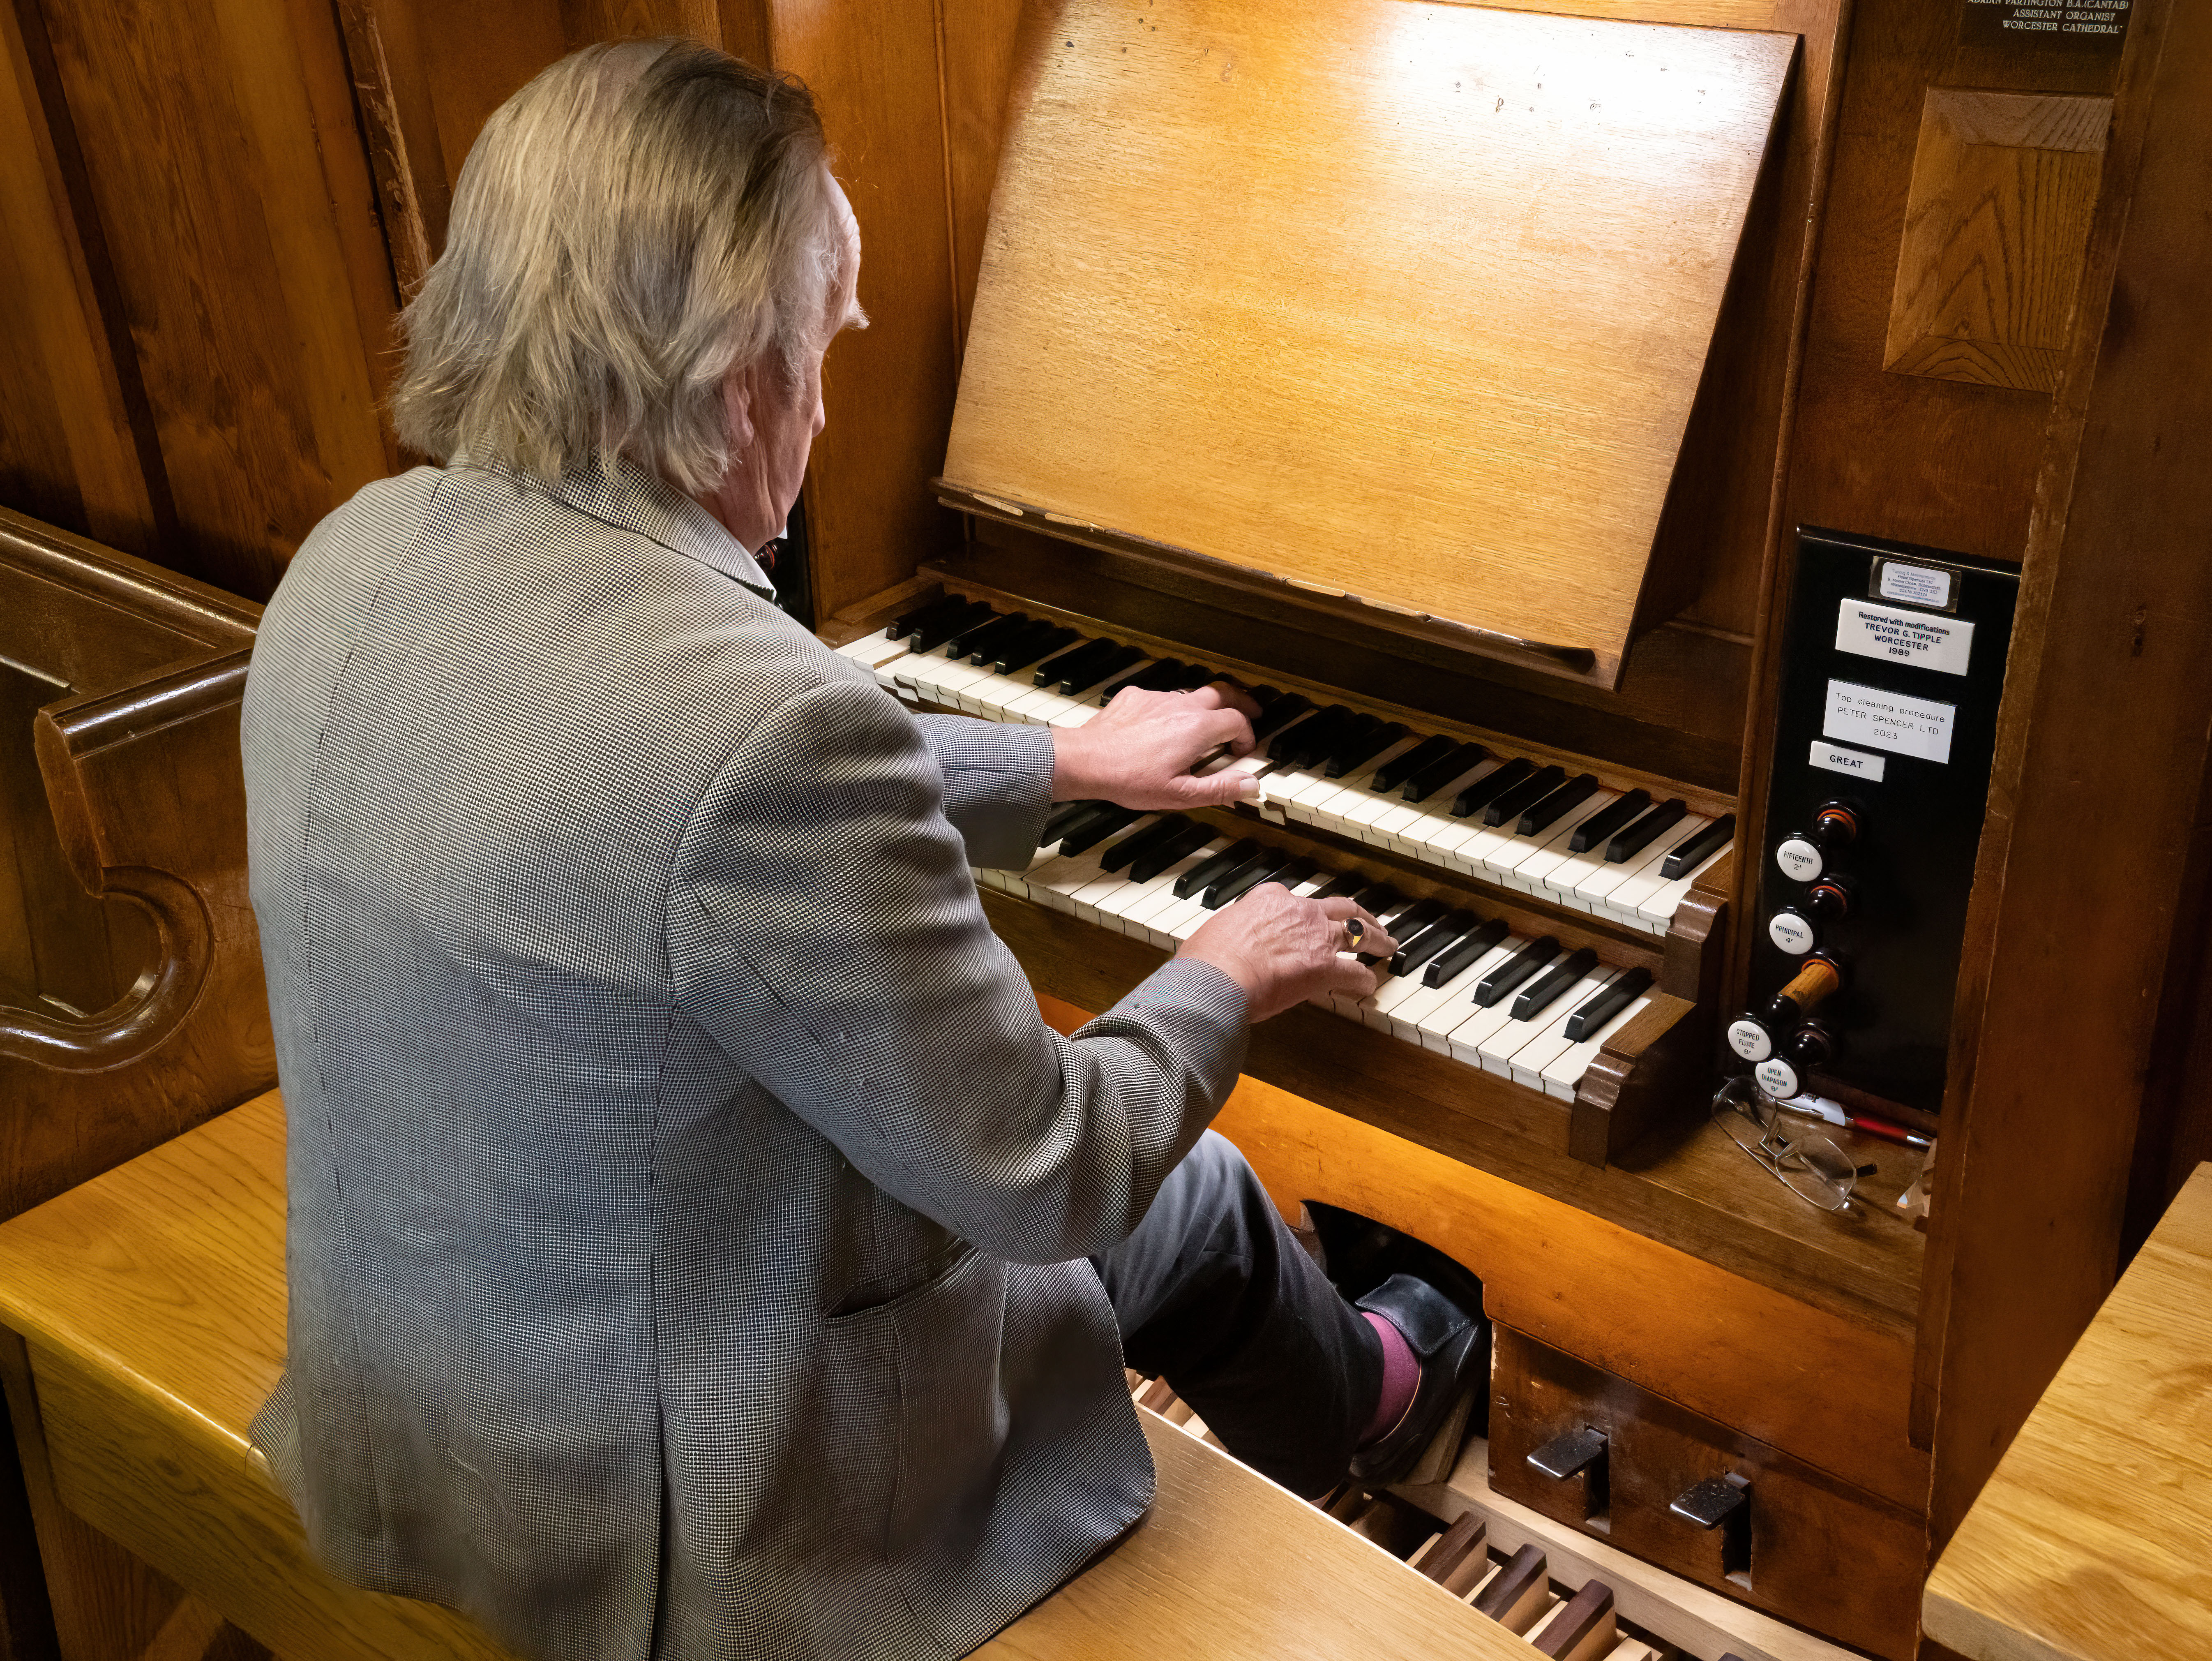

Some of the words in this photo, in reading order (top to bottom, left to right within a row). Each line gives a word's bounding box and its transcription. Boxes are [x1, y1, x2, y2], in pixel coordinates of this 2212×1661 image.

[2013, 9, 2062, 19] ASSISTANT
[2066, 11, 2115, 21] ORGANIST
[2002, 20, 2057, 31] WORCESTER
[1858, 611, 1888, 624] Restored
[1905, 622, 1950, 635] modifications
[1865, 622, 1899, 635] TREVOR
[1912, 632, 1942, 644] TIPPLE
[1875, 634, 1928, 651] WORCESTER
[1889, 647, 1910, 656] 1989
[1836, 693, 1852, 702] Top
[1858, 699, 1894, 713] cleaning
[1900, 708, 1945, 722] procedure
[1838, 707, 1866, 719] PETER
[1873, 714, 1914, 729] SPENCER
[1920, 725, 1939, 735] LTD
[1874, 729, 1898, 739] 2023
[1830, 755, 1863, 769] GREAT
[1784, 851, 1813, 864] FIFTEENTH
[1776, 924, 1804, 938] PRINCIPAL
[1737, 1028, 1760, 1041] STOPPED
[1739, 1038, 1755, 1049] FLUTE
[1767, 1067, 1781, 1077] OPEN
[1762, 1074, 1787, 1087] DIAPASON
